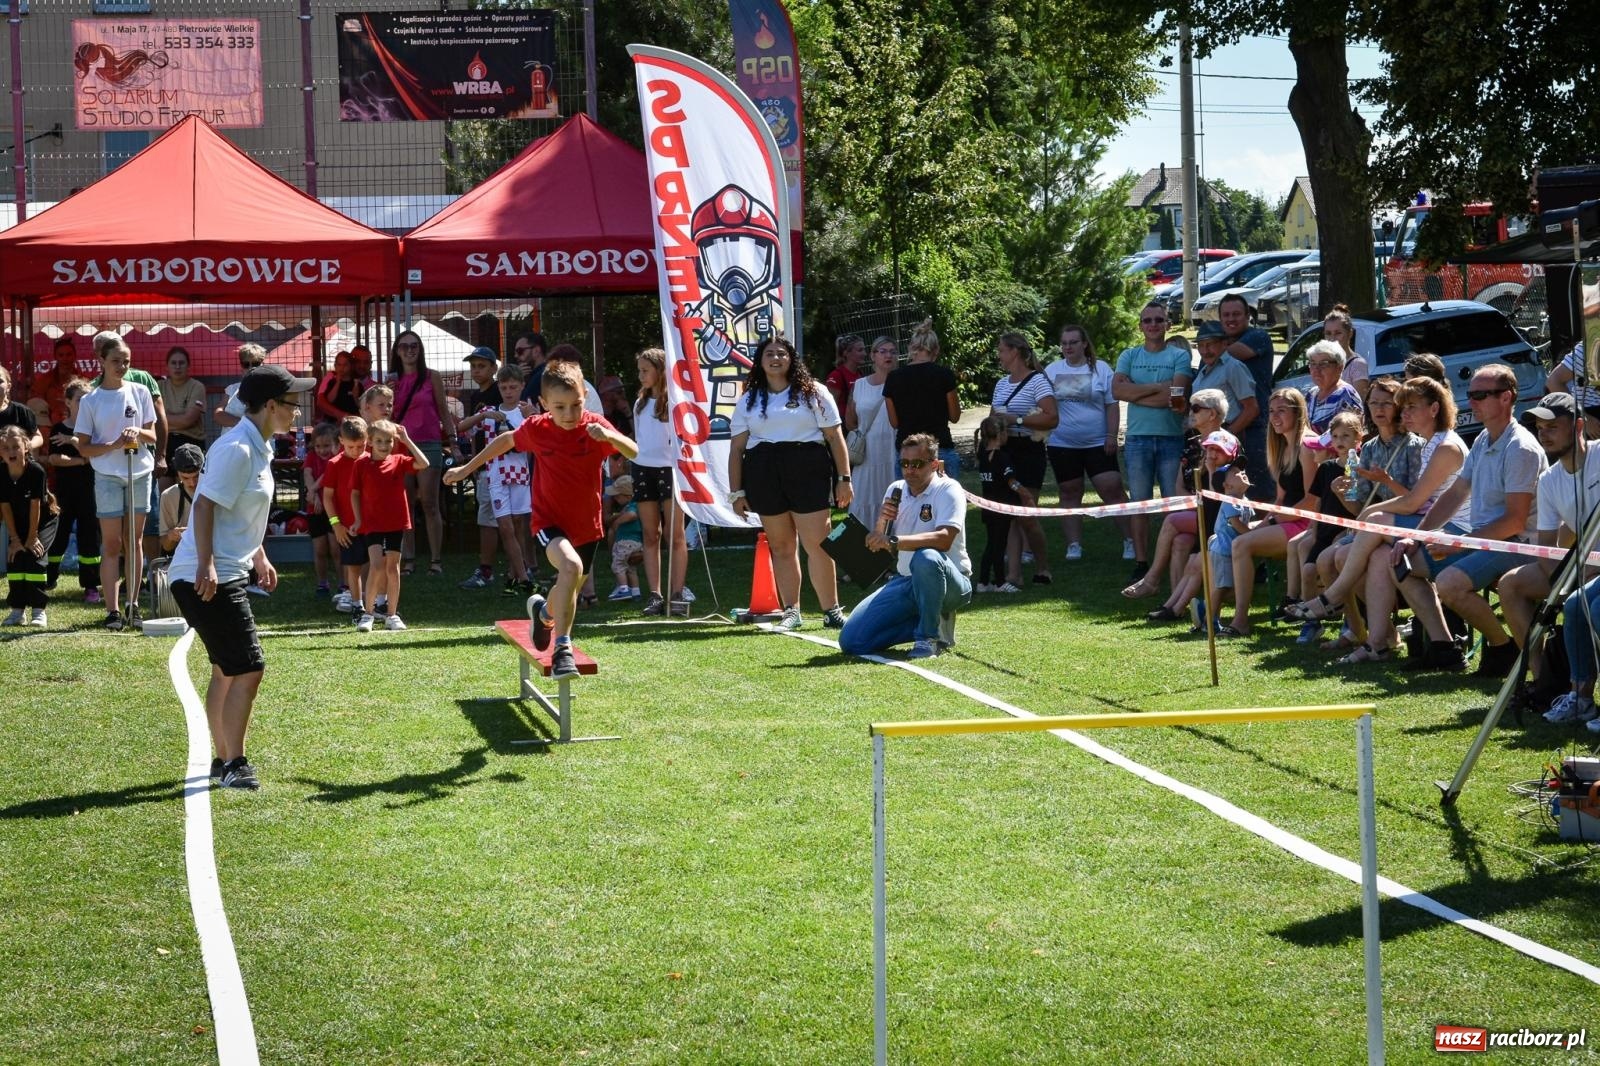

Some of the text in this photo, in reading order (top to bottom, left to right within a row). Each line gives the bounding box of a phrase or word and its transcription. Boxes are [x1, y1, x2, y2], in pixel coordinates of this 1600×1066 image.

[117, 25, 137, 35] Maja
[179, 24, 222, 33] Pietrowice
[224, 24, 255, 33] Wielkie
[142, 36, 255, 49] tel. 533 354 333
[82, 86, 179, 105] SOLARIUM
[83, 107, 154, 126] STUDIO
[52, 257, 341, 284] SAMBOROWICE
